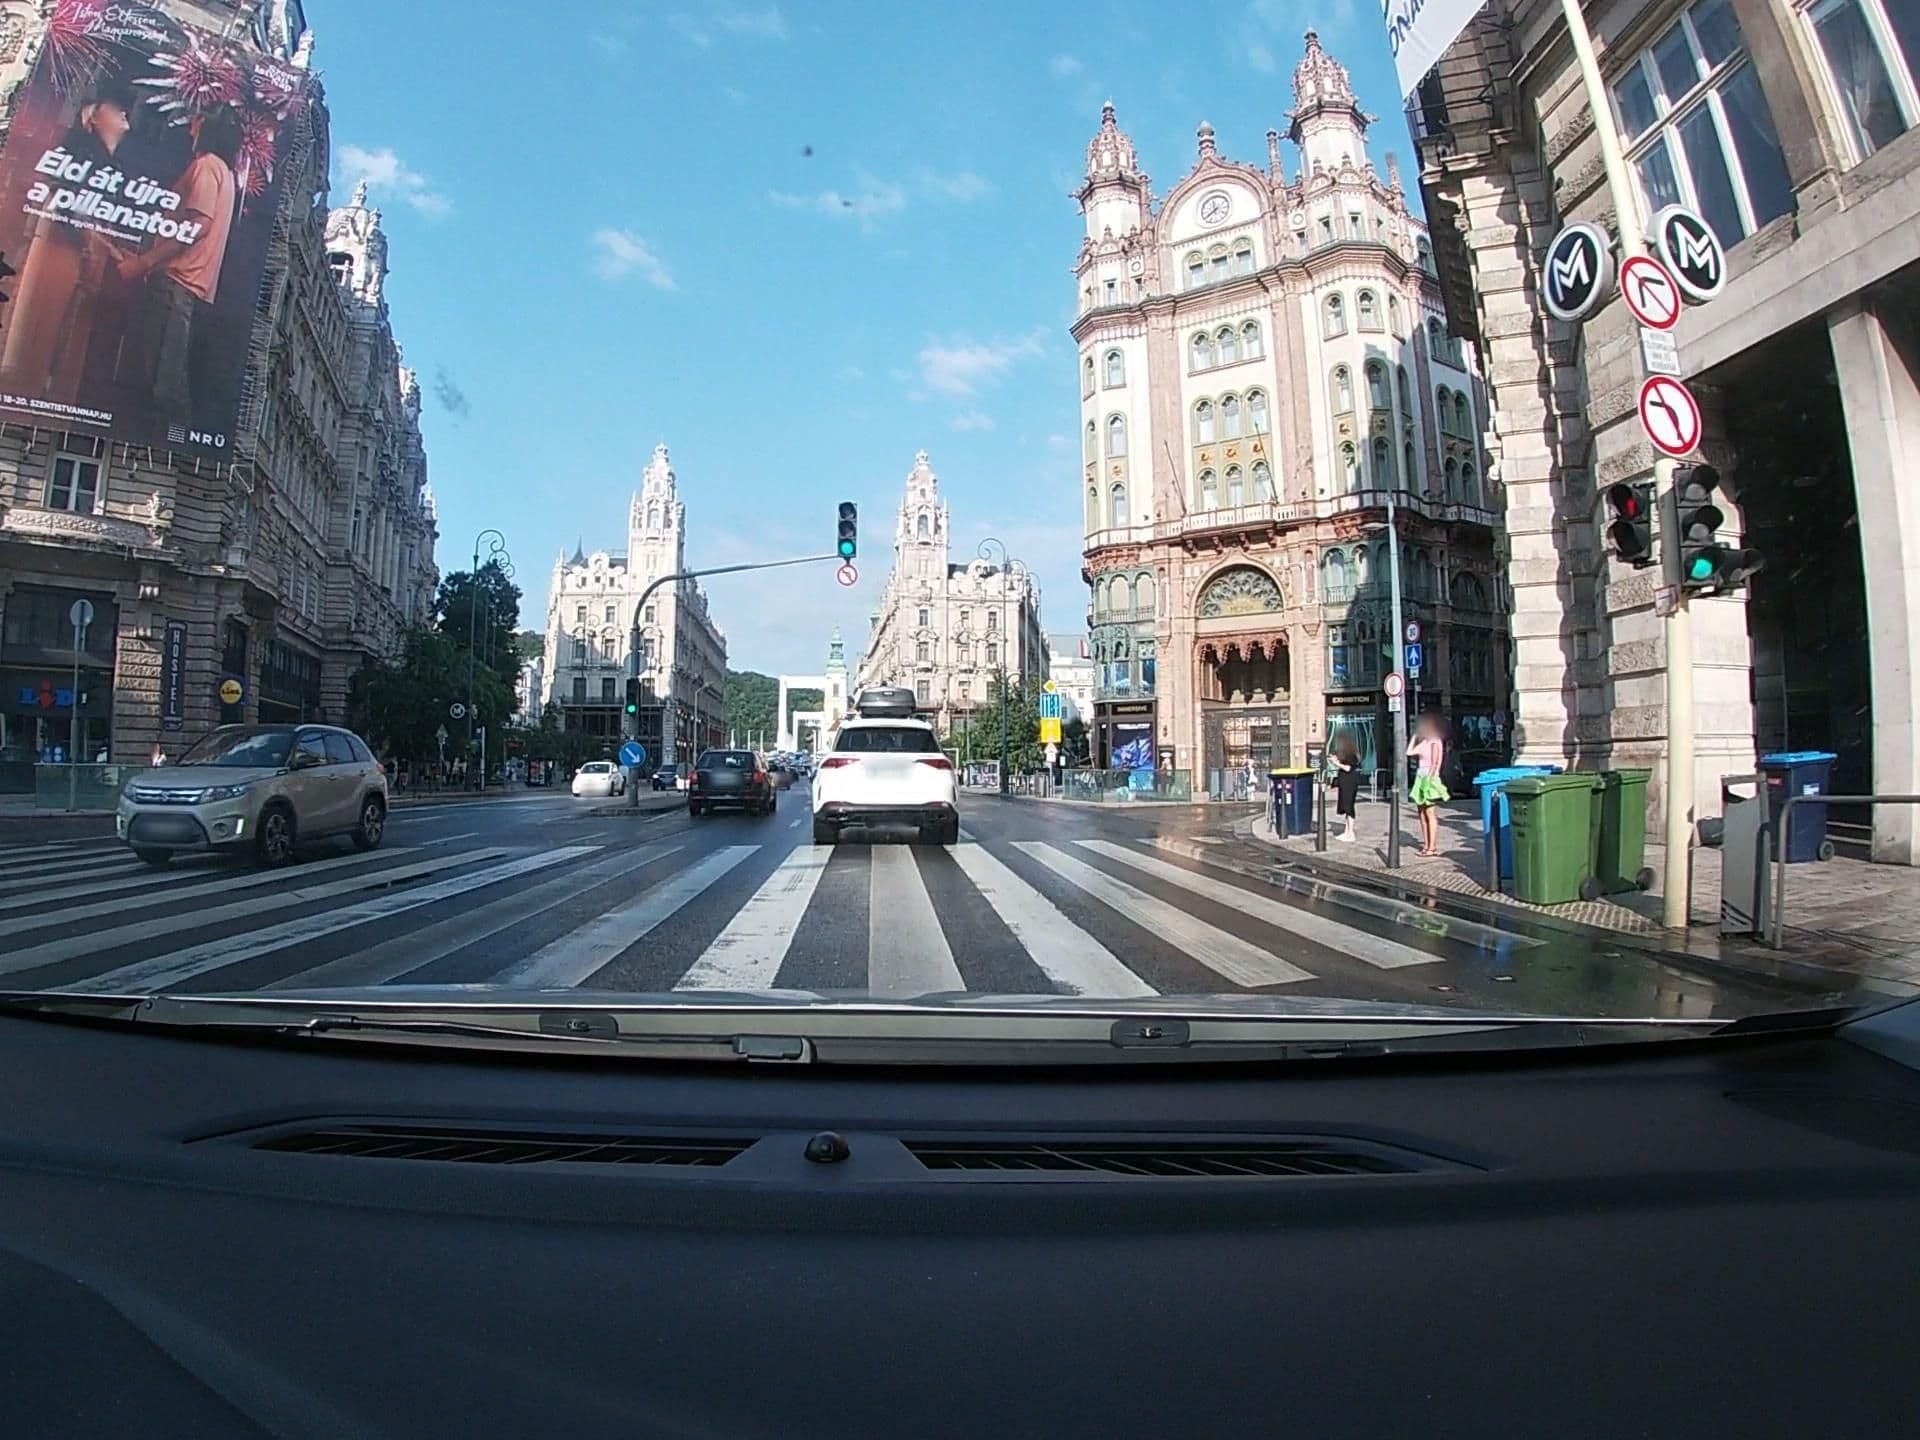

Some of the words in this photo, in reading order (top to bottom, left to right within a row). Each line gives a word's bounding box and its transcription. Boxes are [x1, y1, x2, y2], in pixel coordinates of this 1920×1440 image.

[34, 146, 93, 183] Éld
[88, 166, 124, 194] át
[124, 176, 181, 211] újra
[27, 181, 50, 203] a
[47, 188, 203, 245] pillanatot!
[169, 629, 181, 716] HOSTEL
